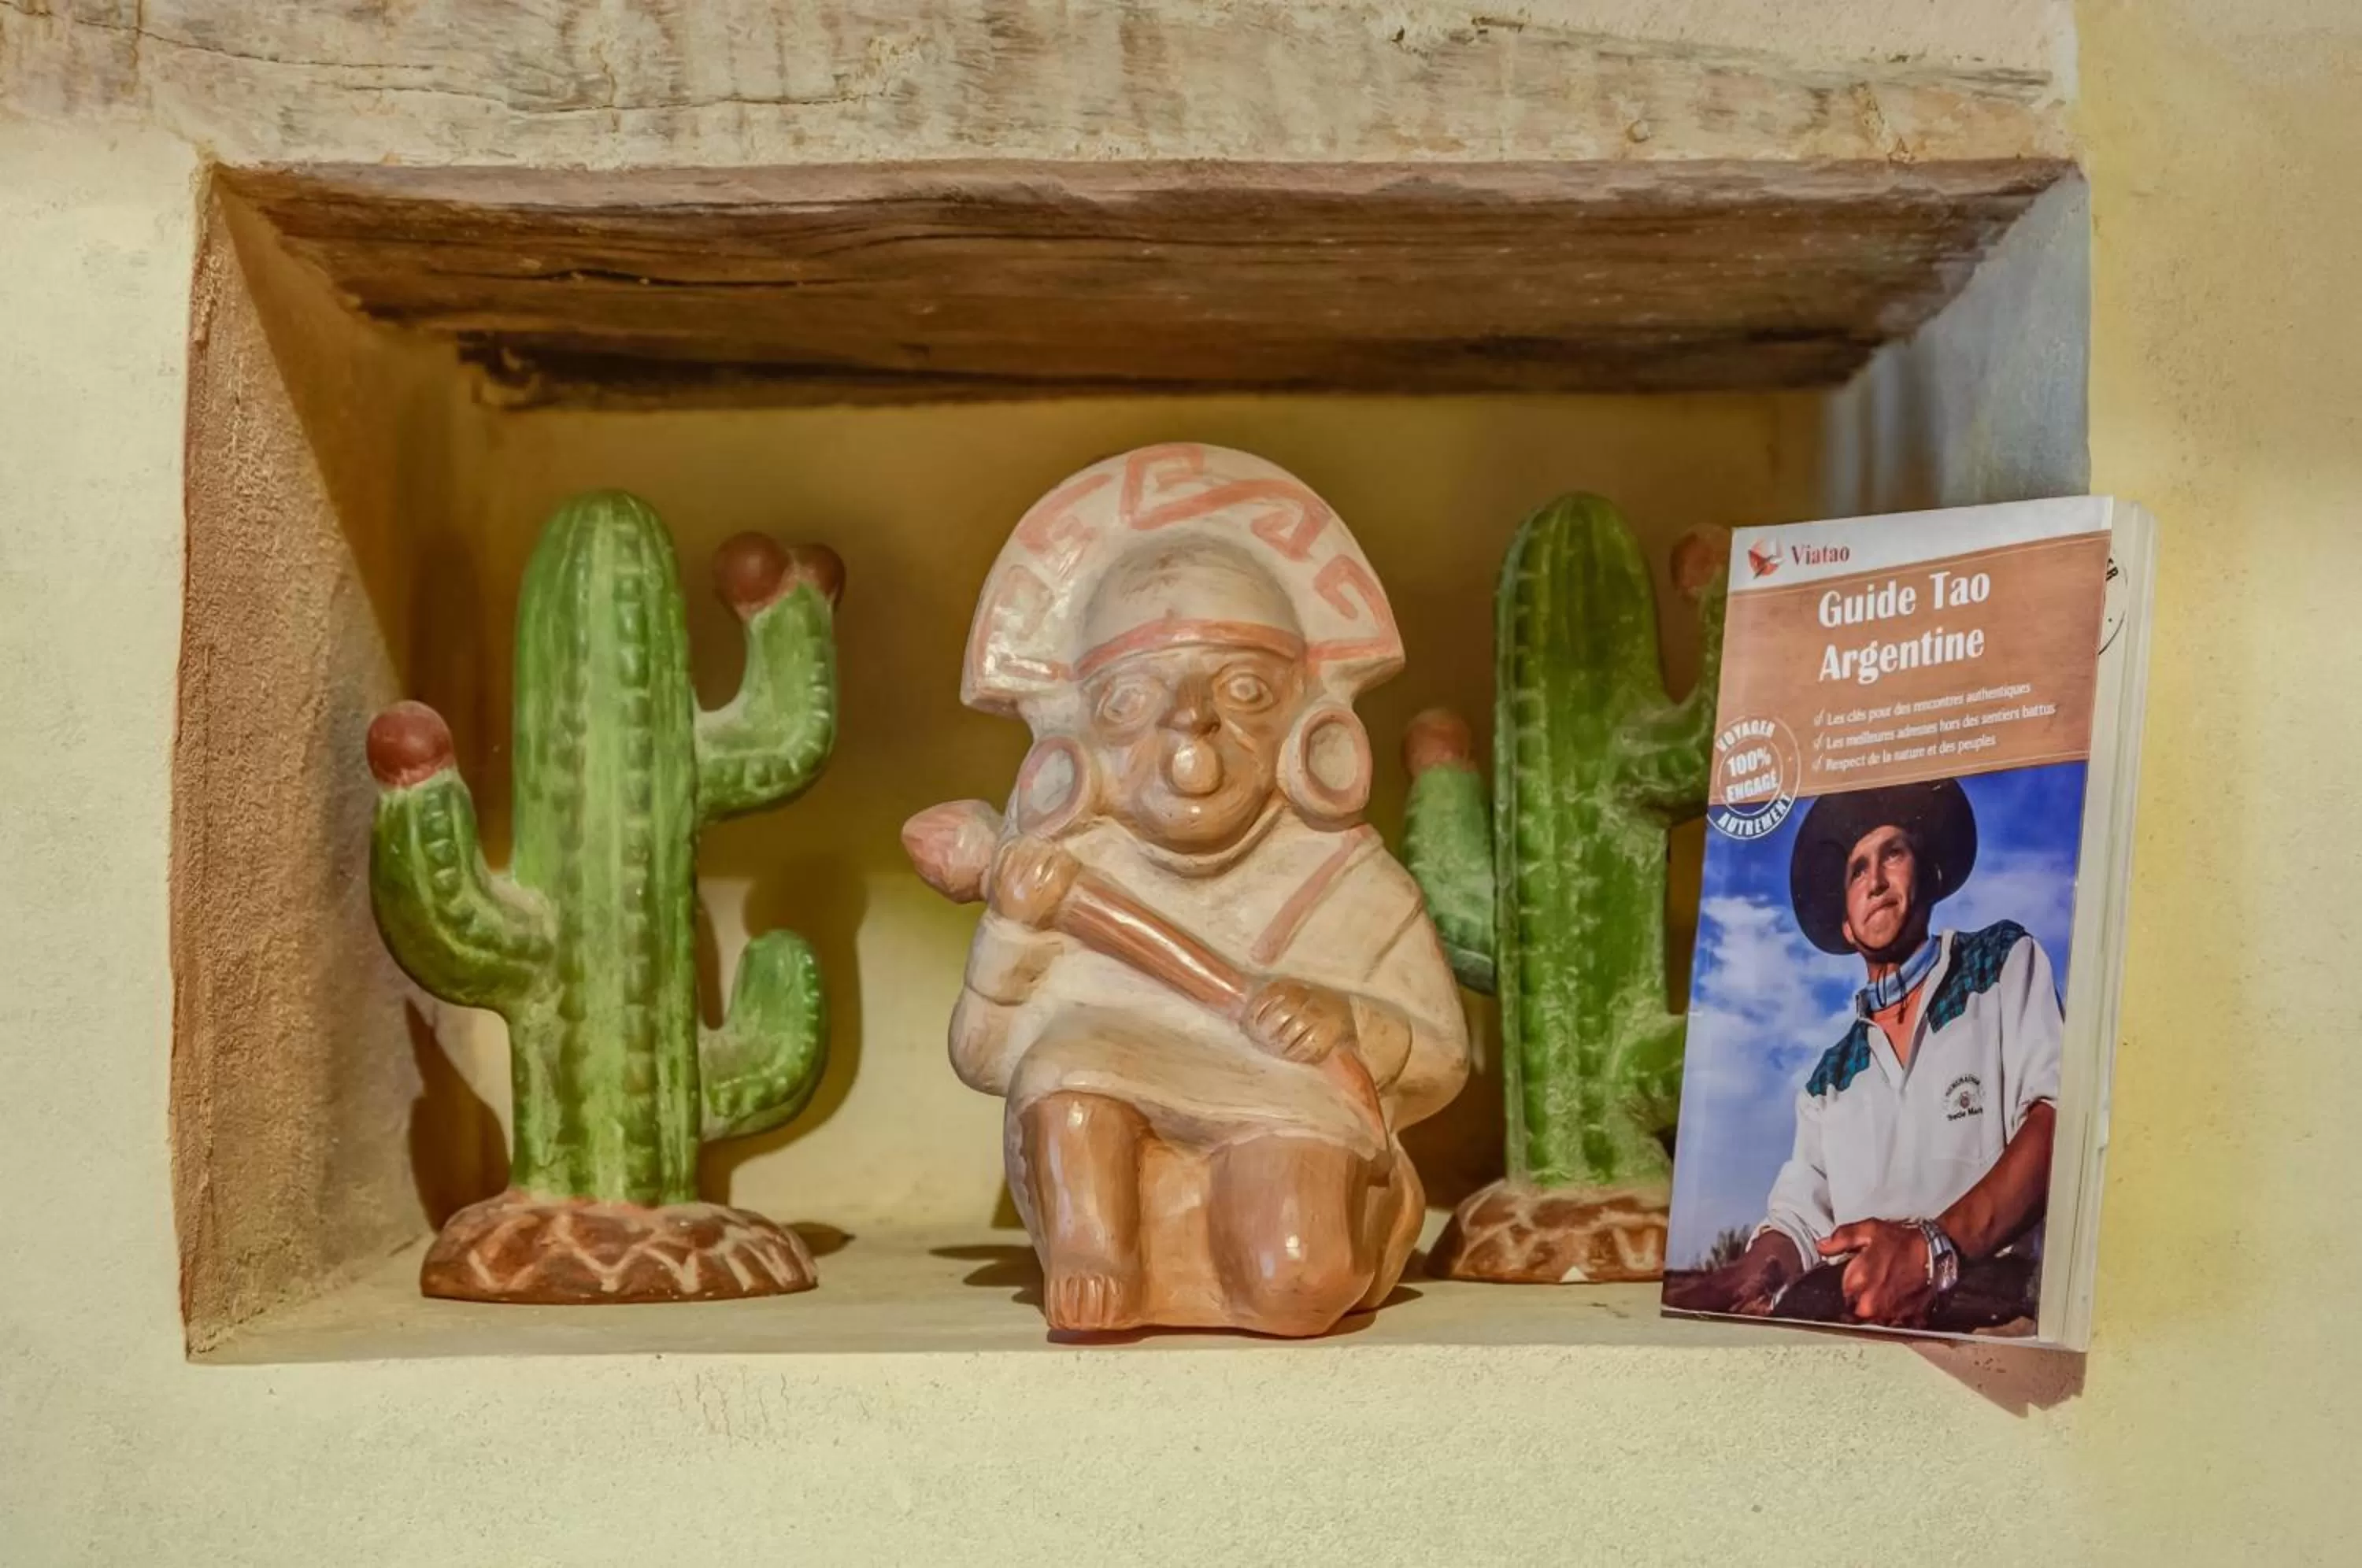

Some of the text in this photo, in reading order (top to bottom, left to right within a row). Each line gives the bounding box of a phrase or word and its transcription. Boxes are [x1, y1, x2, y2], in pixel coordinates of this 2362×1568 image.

[1791, 544, 1850, 566] Viatao
[1818, 570, 1991, 628] Guide Tao
[1818, 627, 1985, 685] Argentine
[1827, 682, 2031, 726] Les clés pour des rencontres authentiques
[1715, 719, 1776, 753] VOYAGER
[1827, 703, 2057, 750] Les meilleures adresses hors des sentiers battus
[1727, 745, 1772, 778] 100%
[1826, 733, 1997, 772] Respect de la nature et des peuples
[1717, 790, 1793, 836] AUTREMENT
